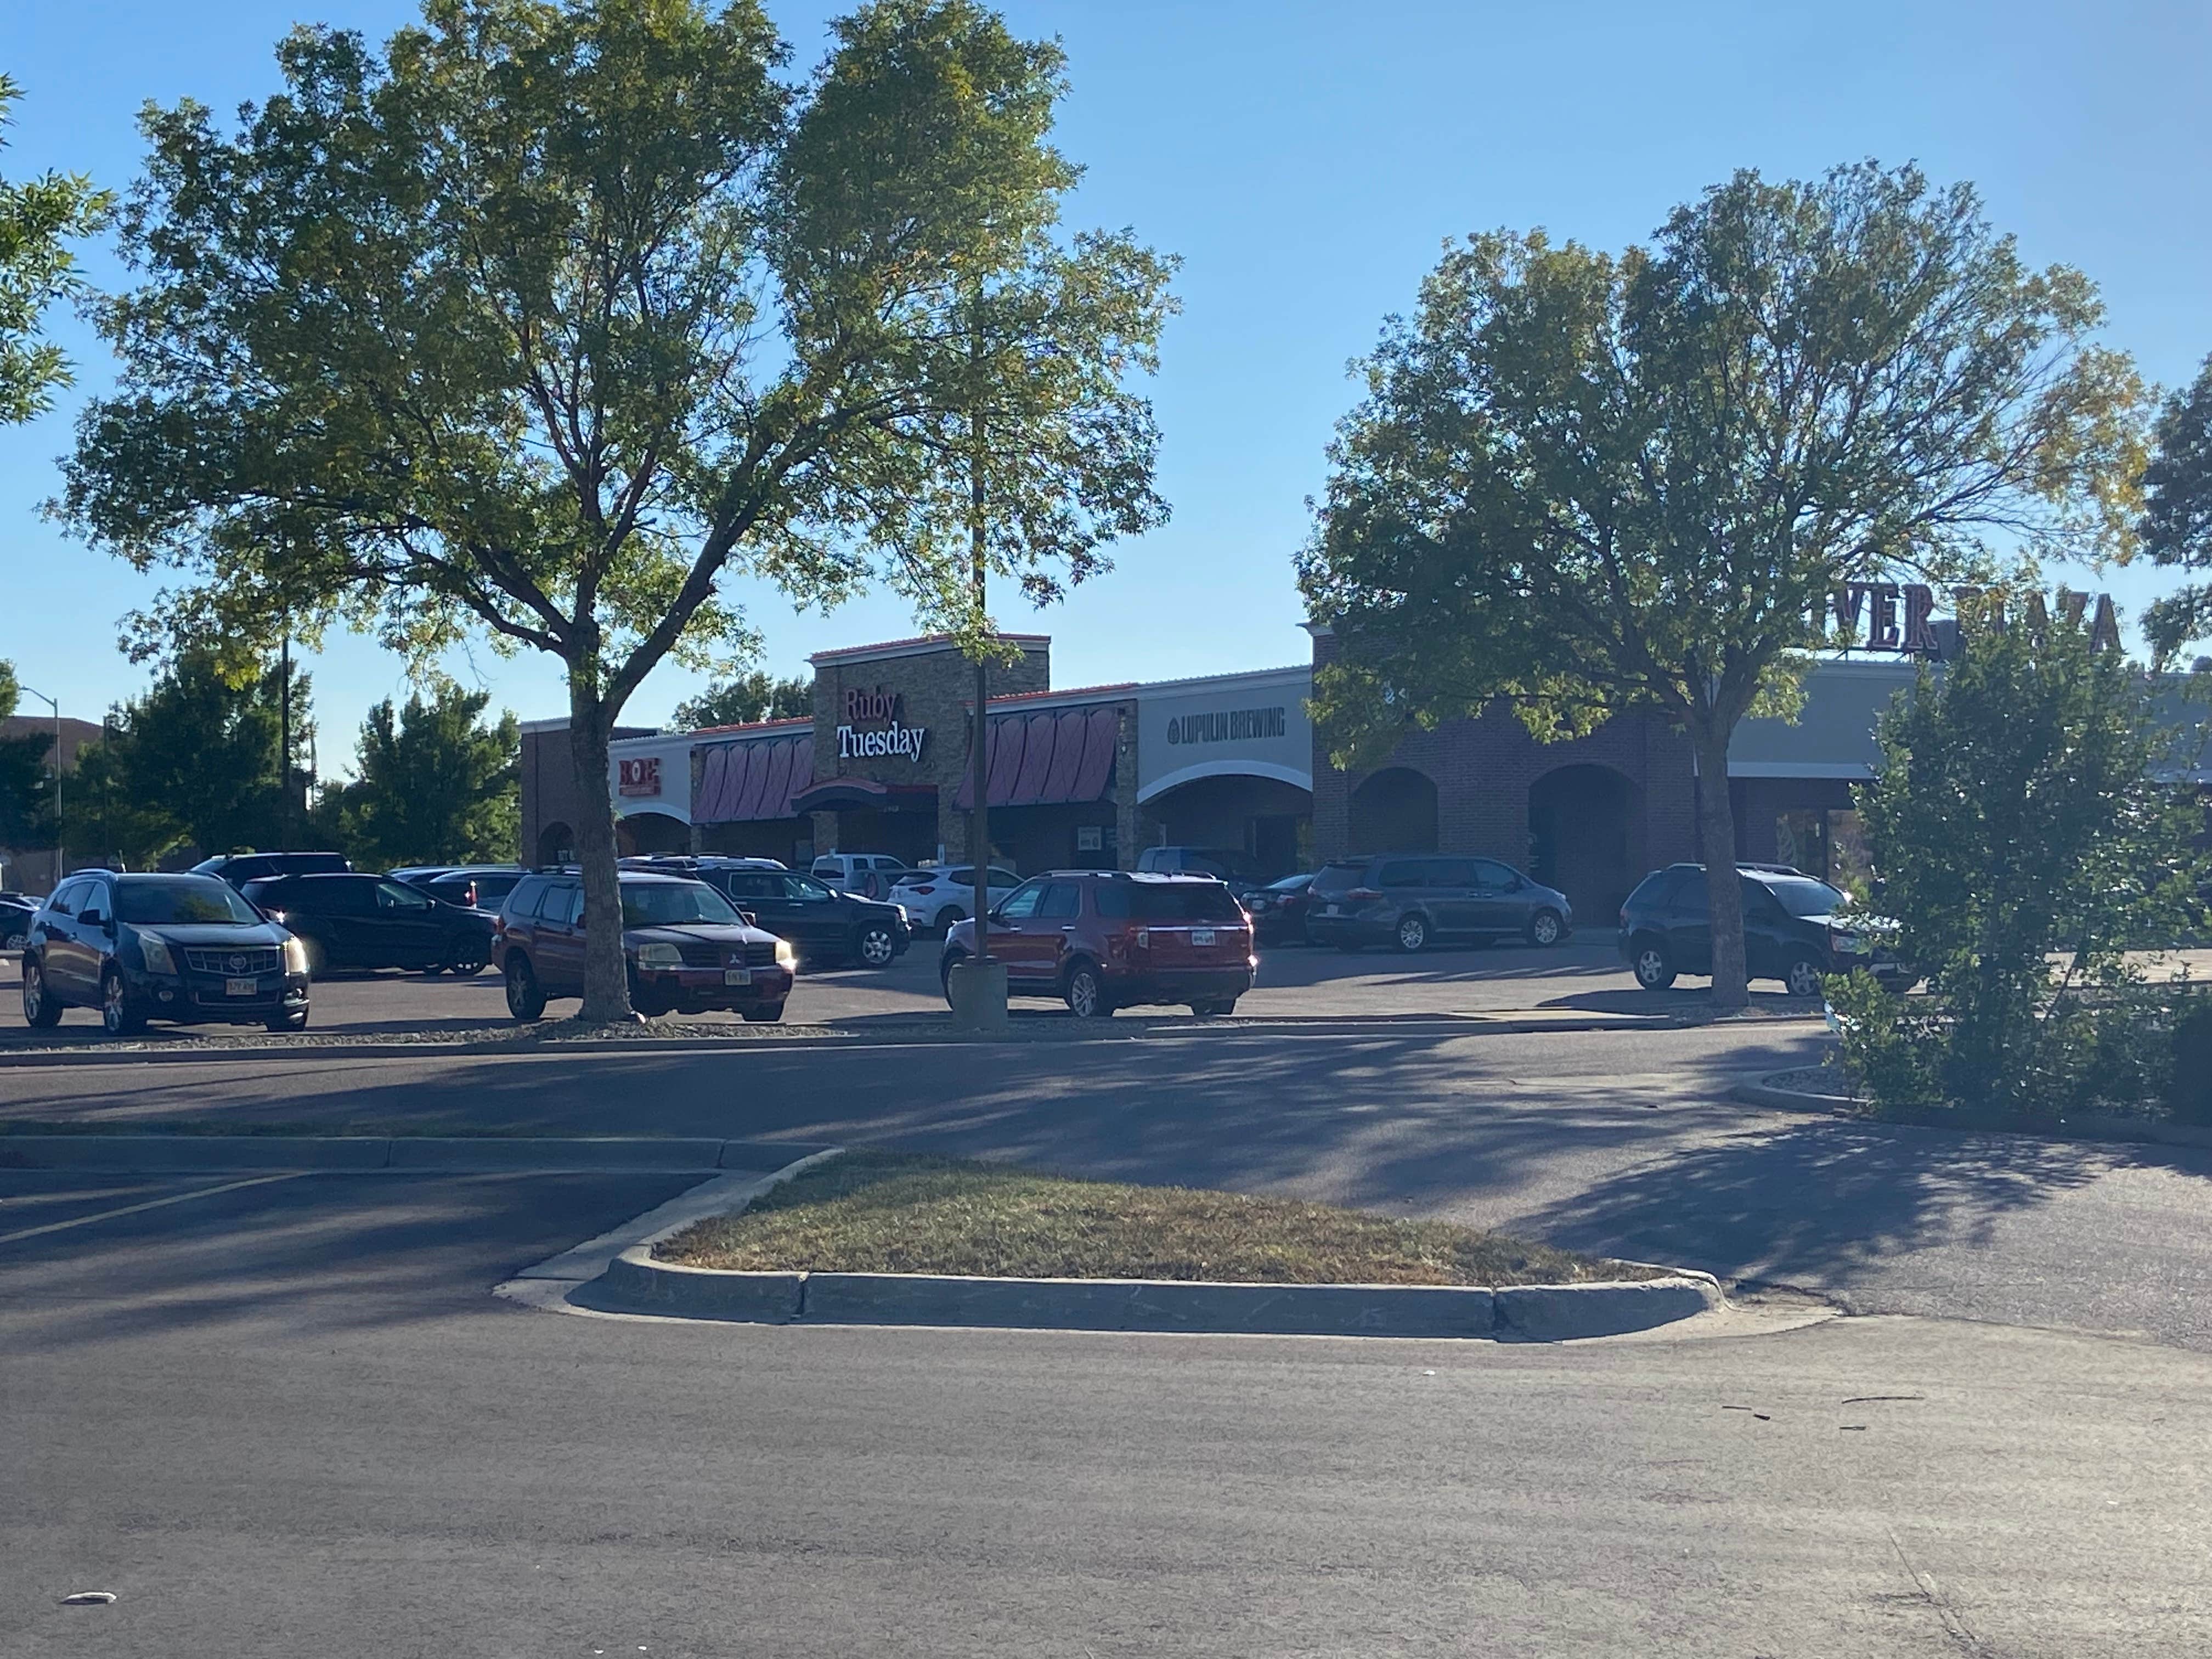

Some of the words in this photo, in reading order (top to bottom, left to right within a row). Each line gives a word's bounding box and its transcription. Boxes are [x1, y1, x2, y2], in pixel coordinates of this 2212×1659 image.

[844, 686, 896, 727] Ruby
[1181, 712, 1229, 744] LUPULIN
[1229, 706, 1285, 741] BREWING
[837, 720, 925, 763] Tuesday
